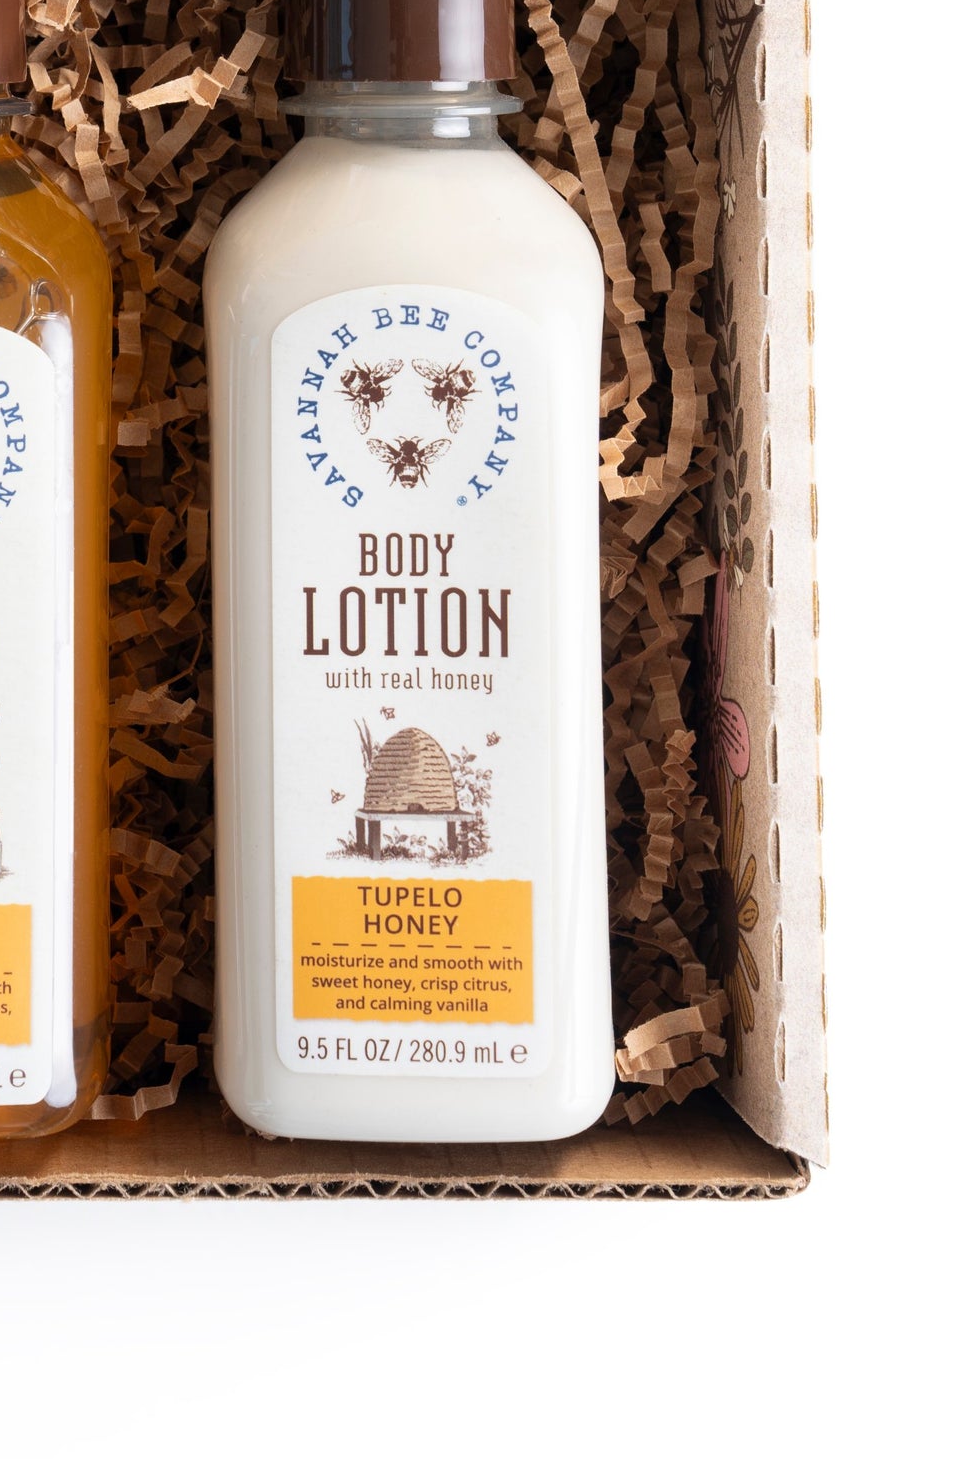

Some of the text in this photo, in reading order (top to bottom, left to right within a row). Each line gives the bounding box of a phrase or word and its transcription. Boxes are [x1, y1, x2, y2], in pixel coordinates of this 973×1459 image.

[298, 323, 363, 508] SAVANNAH
[372, 304, 450, 332] BEE
[359, 533, 454, 577] BODY
[303, 587, 511, 657] LOTION
[326, 667, 492, 694] with real honey
[358, 887, 462, 907] TUPELO
[365, 914, 458, 935] HONEY
[301, 954, 522, 970] moisturize and smooth with
[312, 975, 511, 994] sweet honey, crisp citrus,
[336, 996, 488, 1015] and calming vanilla
[298, 1036, 327, 1059] 9.5
[337, 1038, 357, 1060] FL
[410, 1040, 465, 1063] 280.9
[475, 1042, 503, 1063] mL
